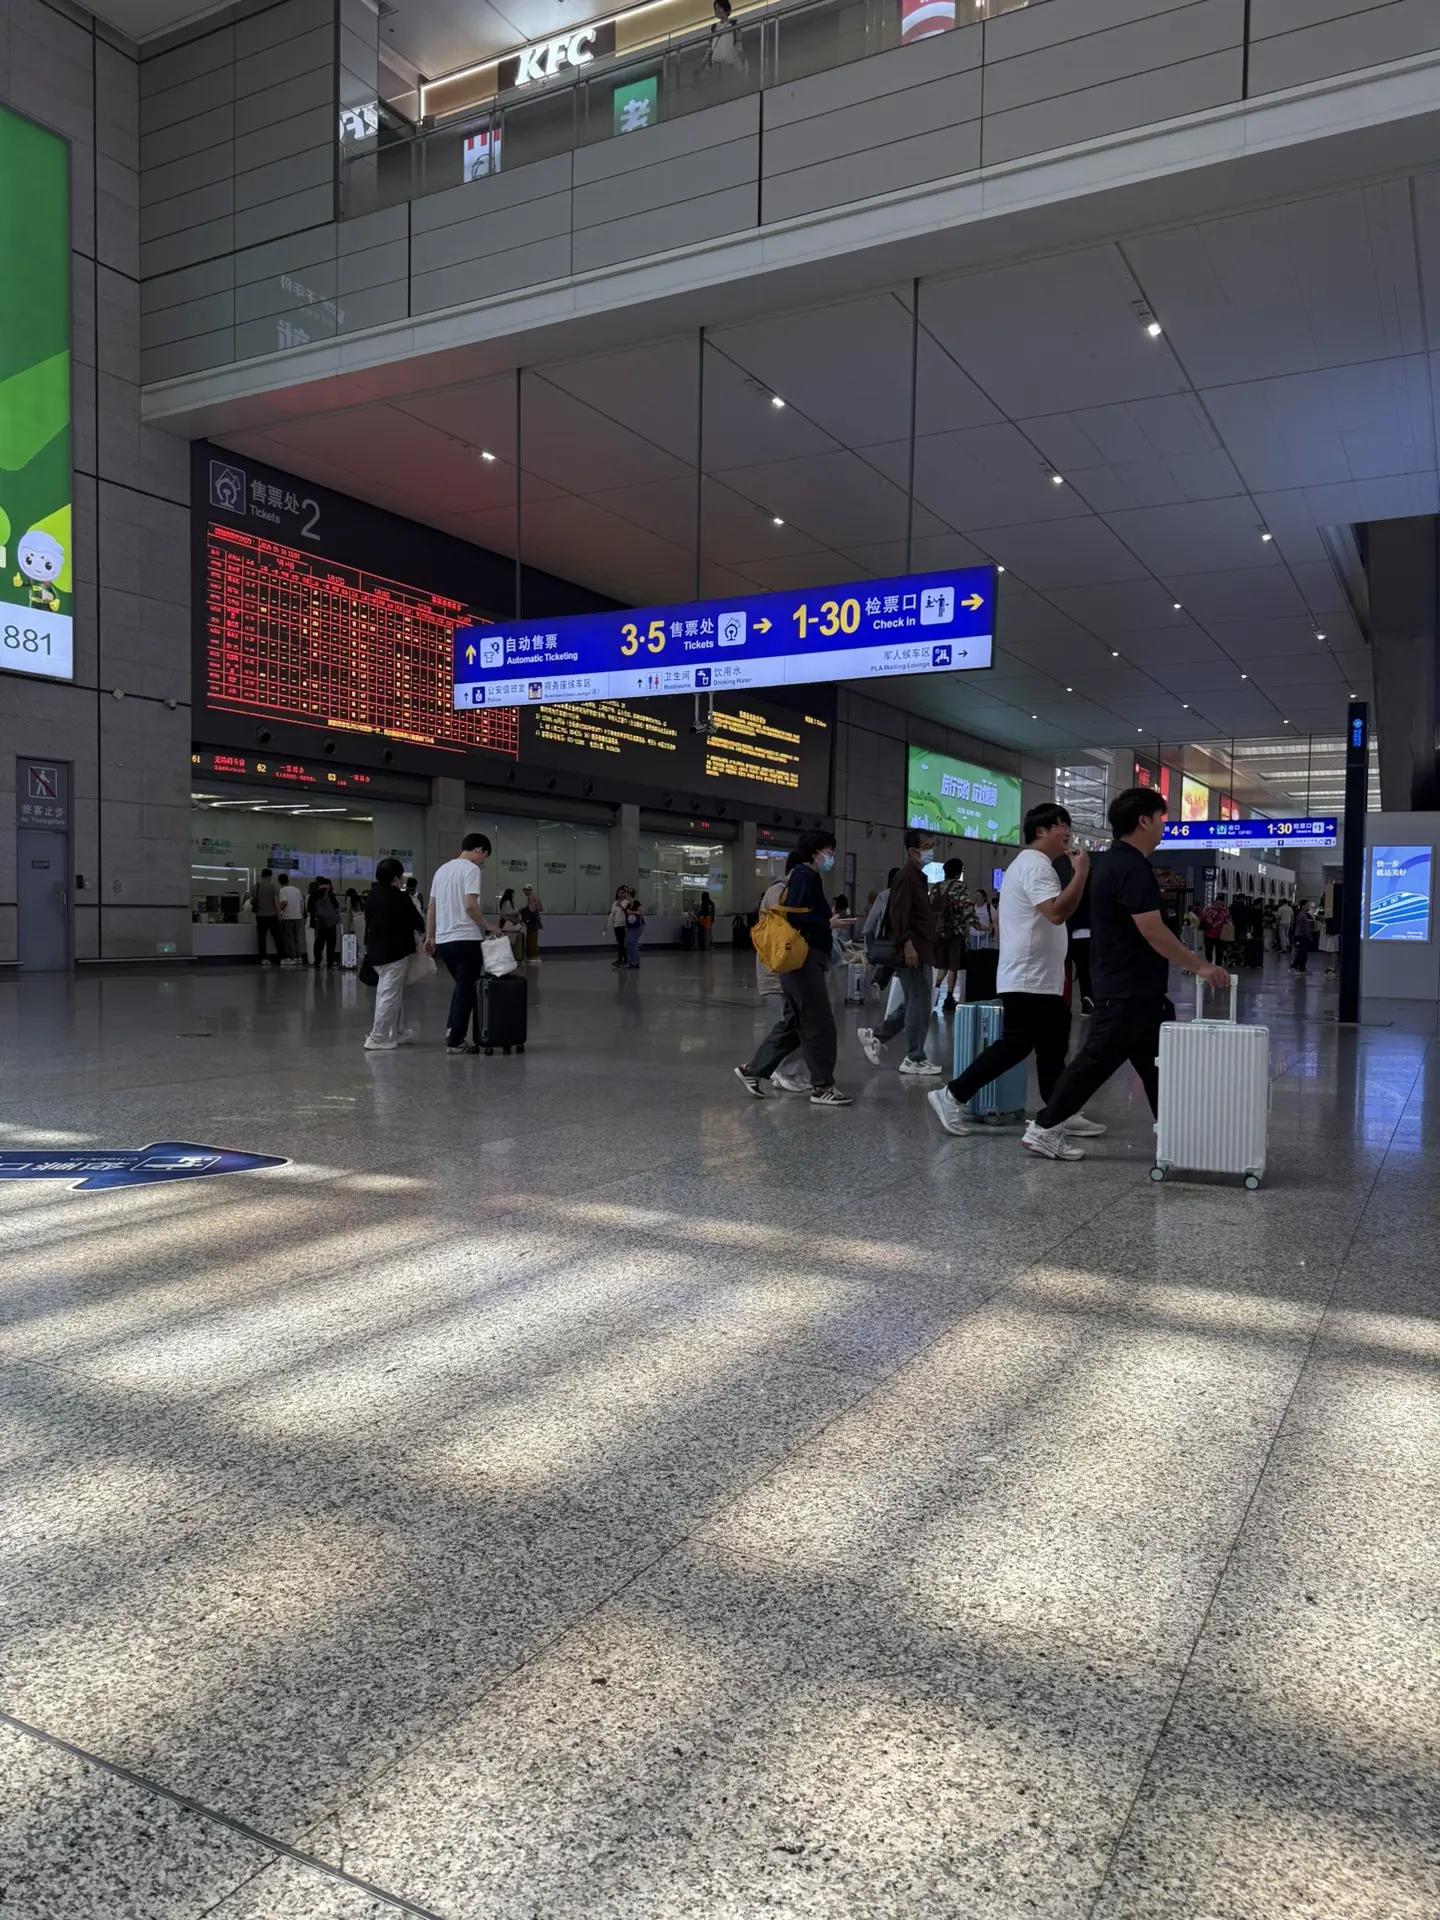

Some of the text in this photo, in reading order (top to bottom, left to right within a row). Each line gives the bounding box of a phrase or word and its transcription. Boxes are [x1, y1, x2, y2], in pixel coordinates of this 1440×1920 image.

[514, 27, 597, 86] KFC
[249, 479, 300, 515] 售票处
[301, 498, 320, 541] 2
[249, 504, 281, 524] Tickets
[792, 593, 917, 639] 1-30 检票口
[873, 616, 916, 630] Check in
[669, 617, 714, 638] 售票处
[3, 624, 52, 656] 881
[506, 633, 558, 653] 自动售票
[684, 640, 714, 651] Tickets
[506, 651, 578, 665] Automatic Ticketing
[883, 646, 931, 660] 军人候车区
[663, 670, 691, 682] 卫生间
[713, 665, 742, 678] 饮用水
[487, 683, 526, 695] 公安值班室
[544, 678, 591, 692] 商务座候车区
[191, 754, 201, 764] 61
[256, 763, 267, 773] 62
[327, 773, 337, 782] 63
[22, 804, 64, 818] 旅客止步
[1267, 823, 1293, 835] 1-30
[1376, 860, 1399, 868] 快一步
